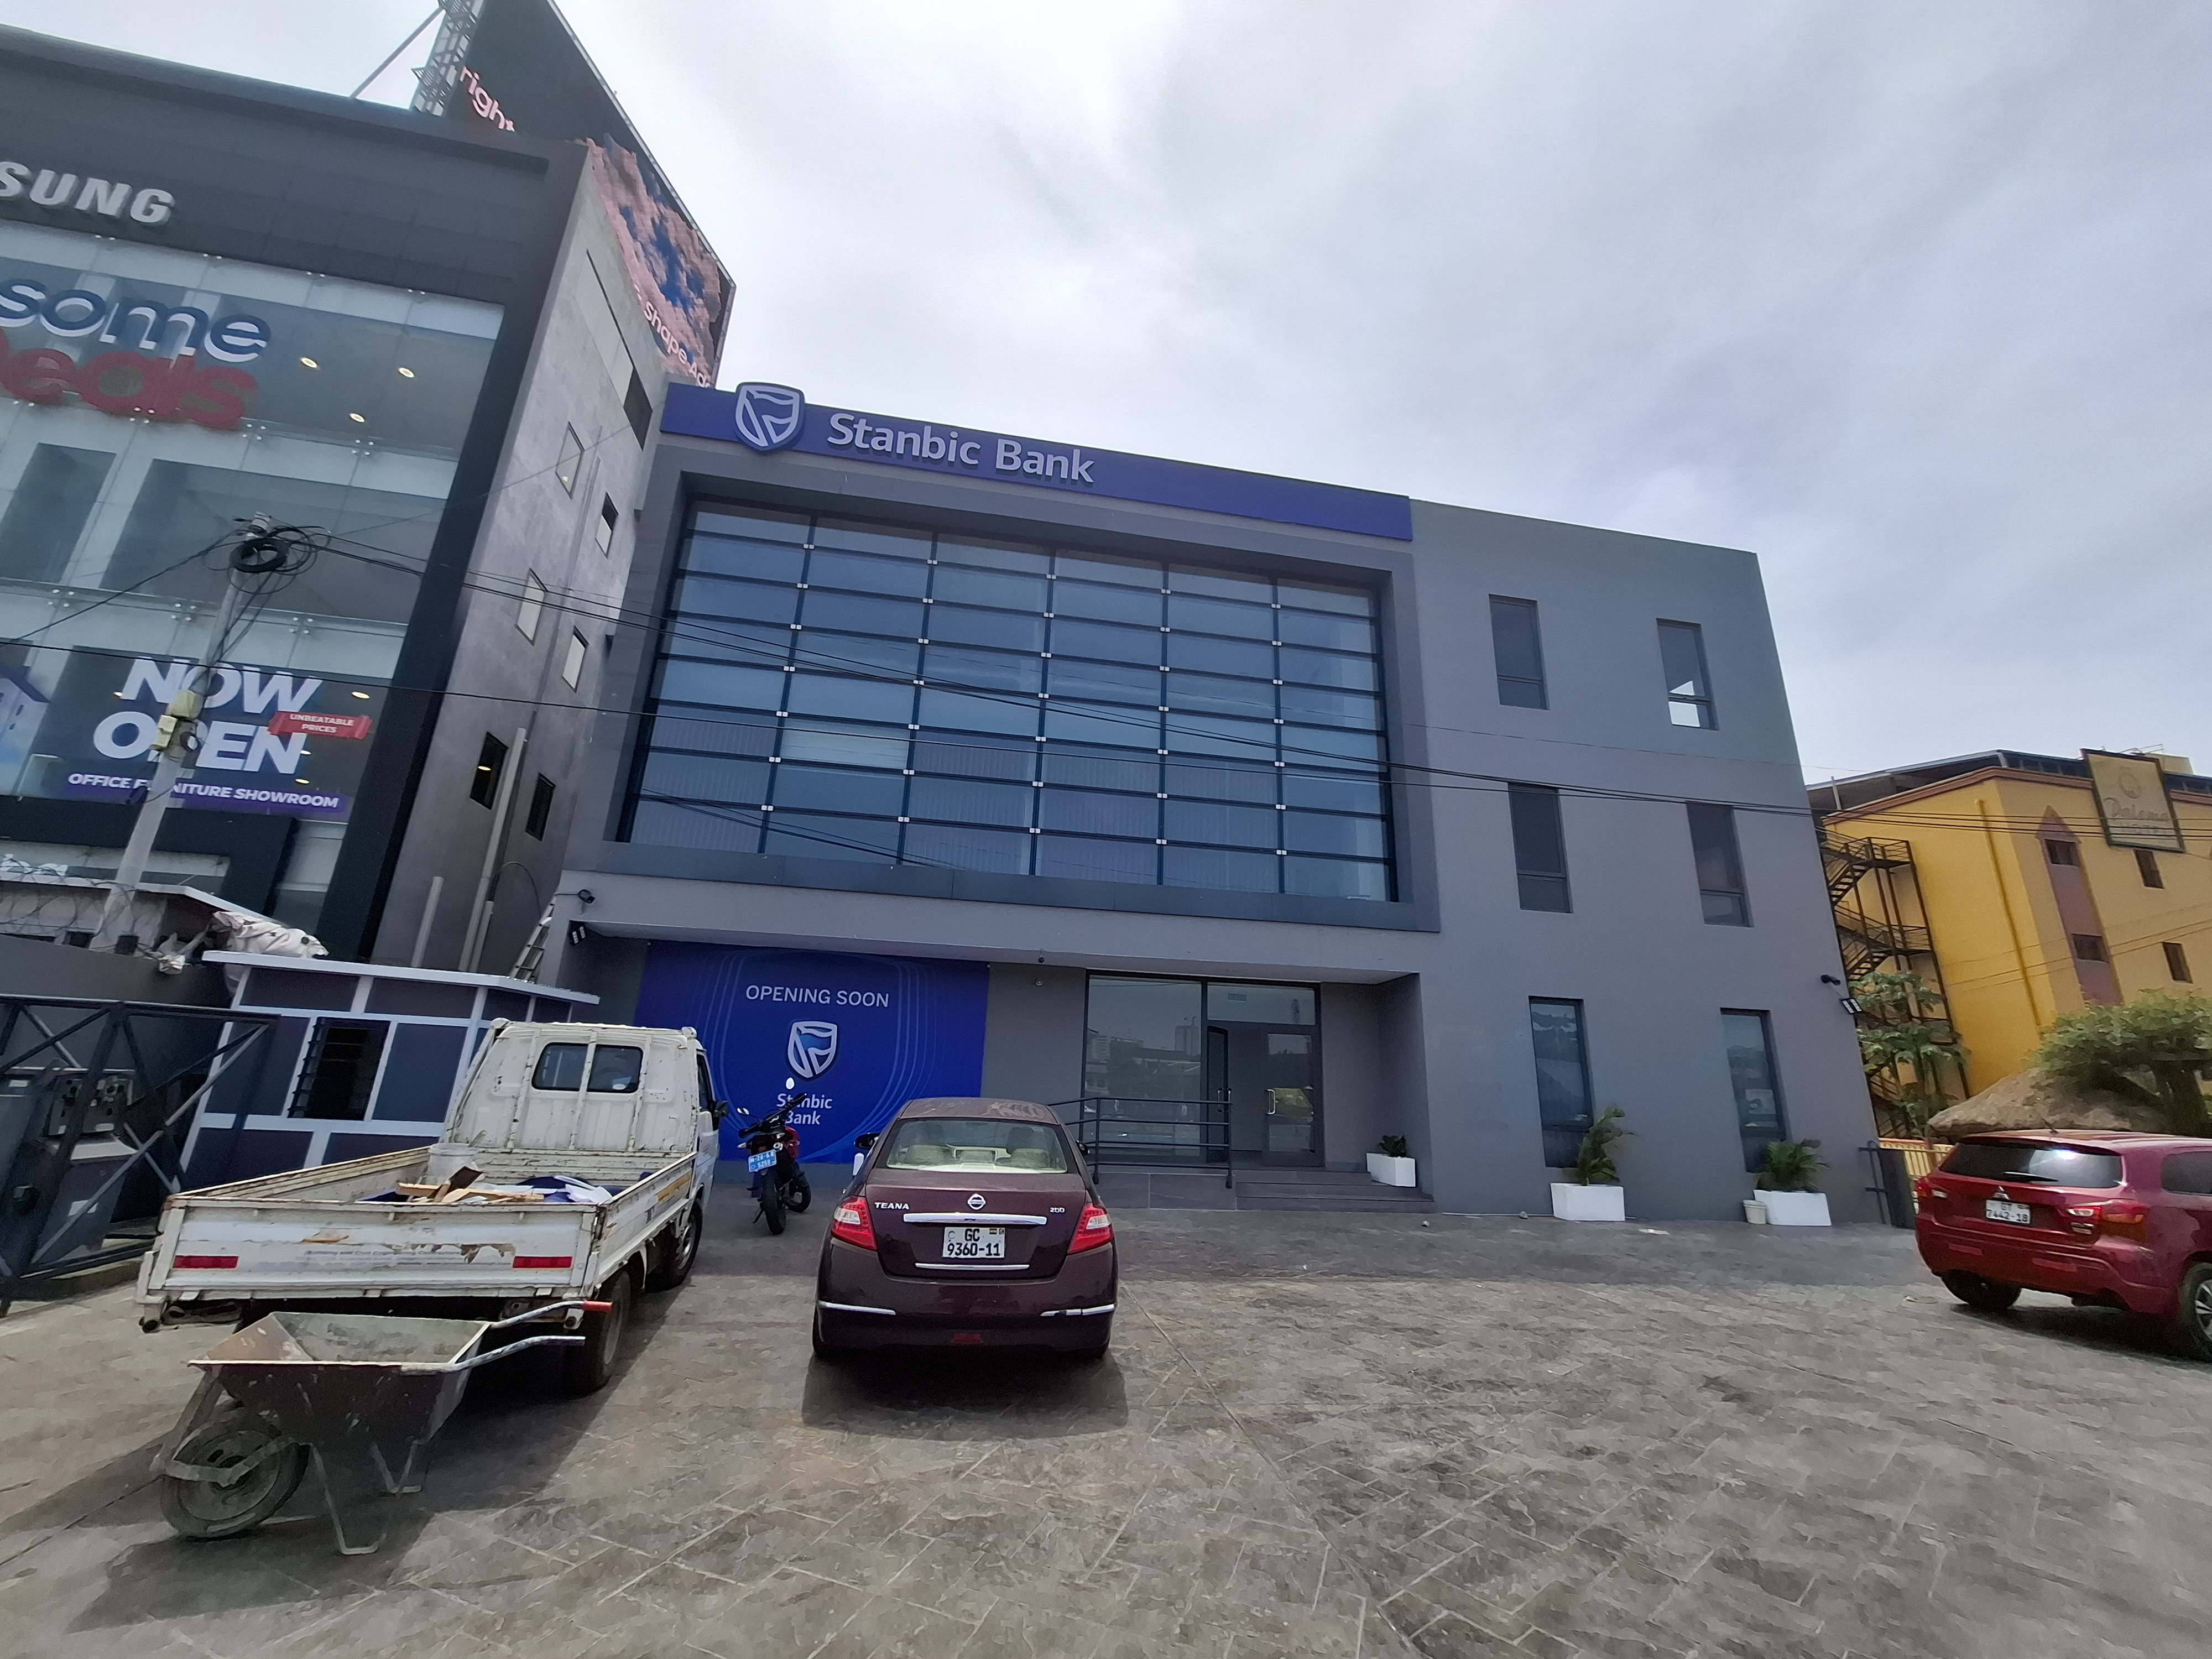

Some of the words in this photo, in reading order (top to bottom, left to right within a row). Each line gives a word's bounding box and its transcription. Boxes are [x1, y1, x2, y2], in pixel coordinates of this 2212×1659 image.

[643, 301, 688, 365] Shape
[0, 327, 258, 431] eals
[827, 413, 980, 466] Stanbic
[995, 438, 1094, 483] Bank
[120, 656, 323, 714] NOW
[289, 713, 354, 727] UNBEATABLE
[301, 724, 338, 733] PRICES
[68, 773, 132, 789] OFFICE
[233, 788, 339, 808] SHOWROOM
[746, 985, 831, 1005] OPENING
[836, 990, 889, 1008] SOON
[874, 1202, 910, 1210] TEANA
[964, 1228, 980, 1242] GC
[947, 1243, 1001, 1256] 9360-11
